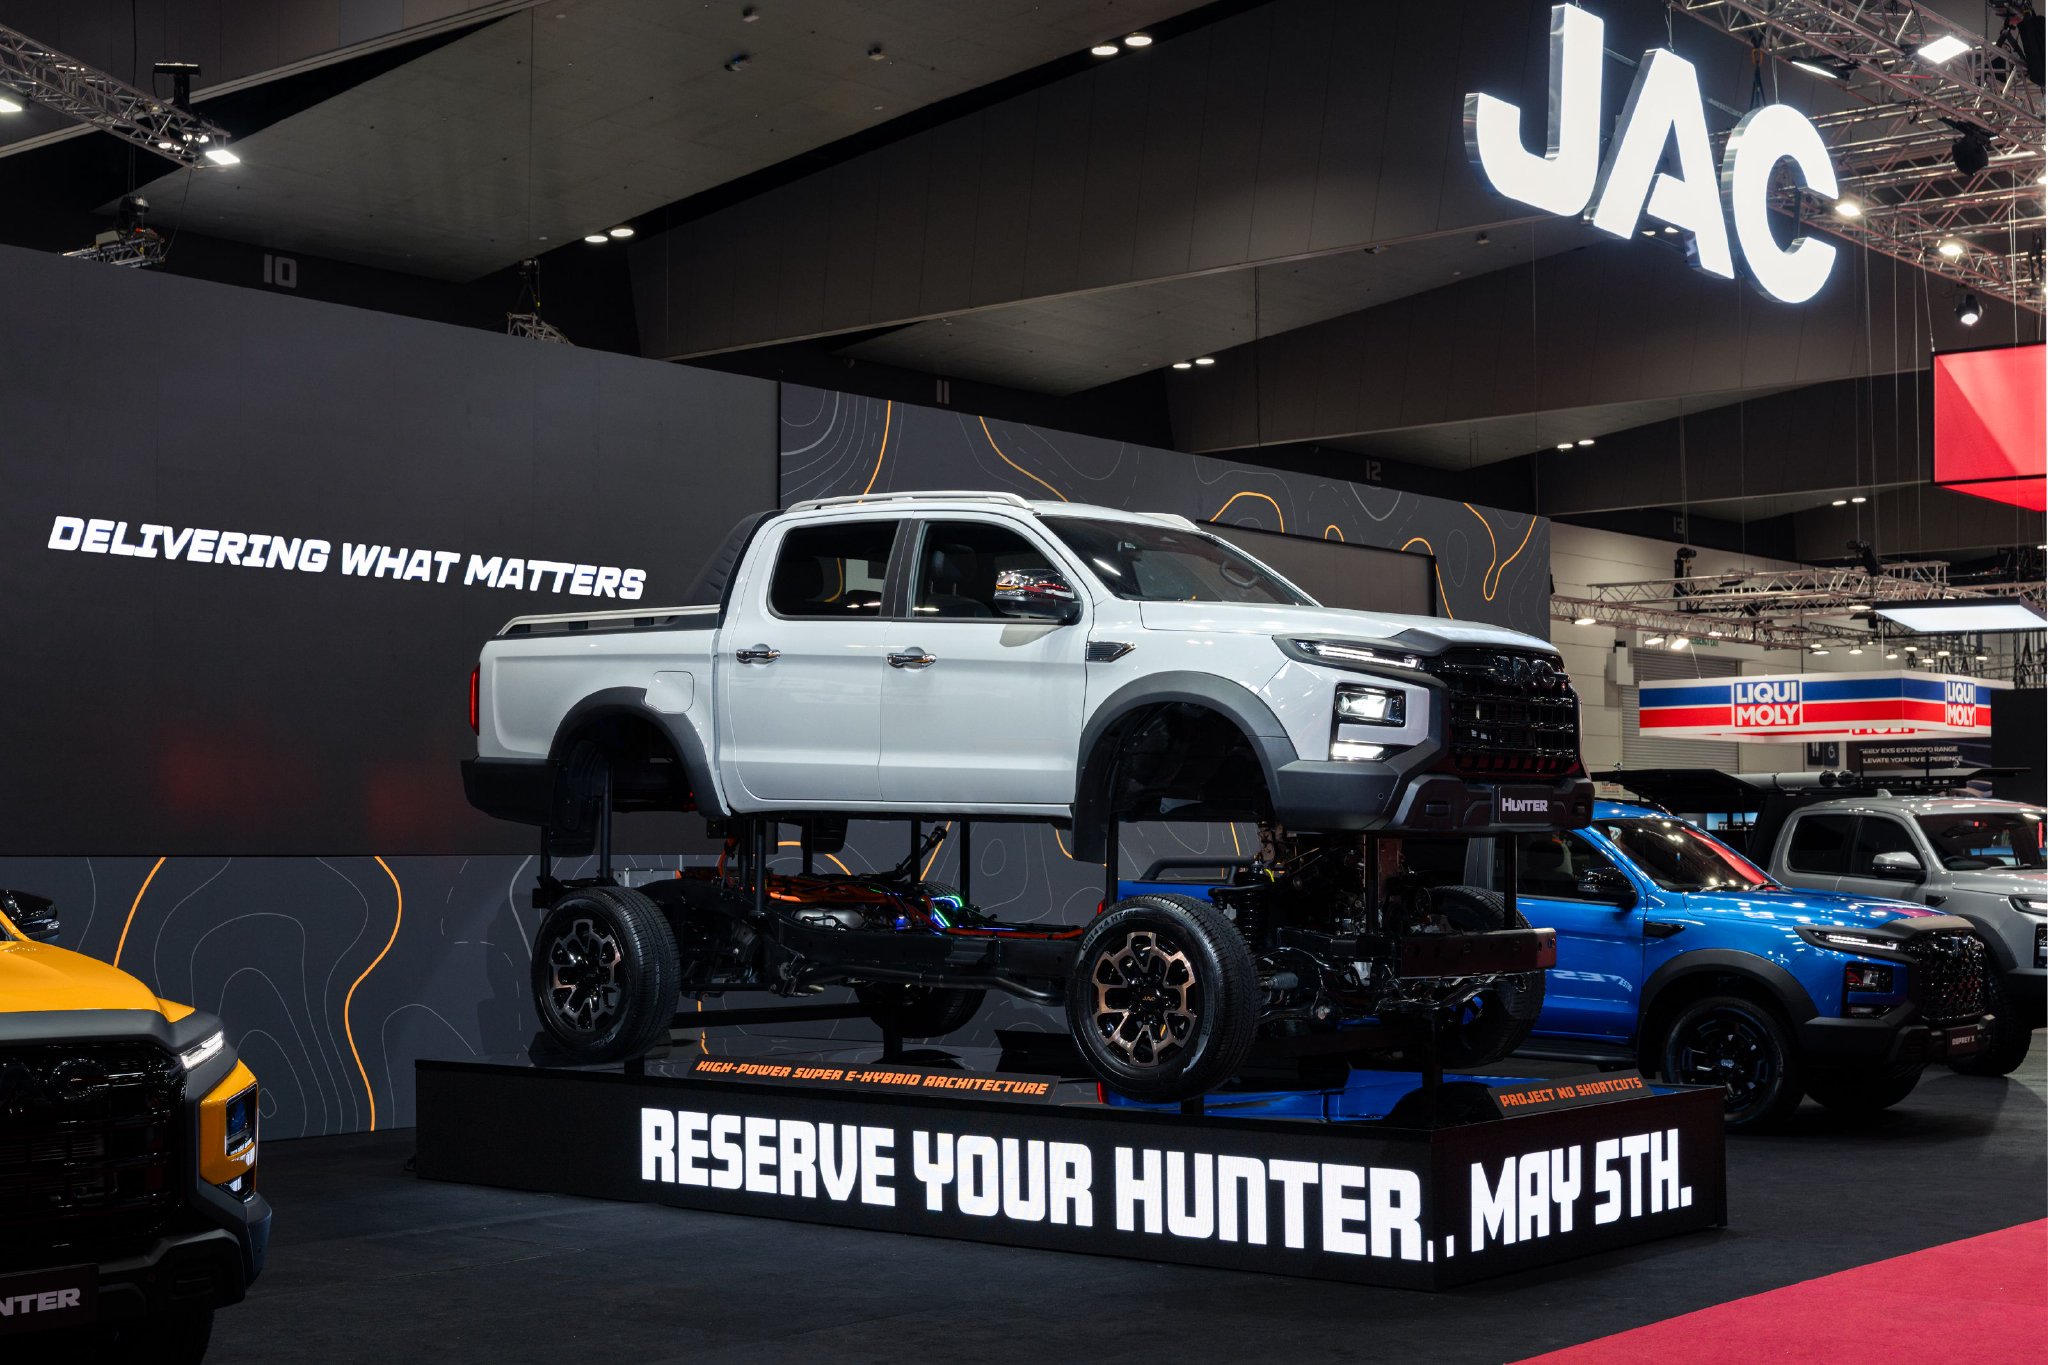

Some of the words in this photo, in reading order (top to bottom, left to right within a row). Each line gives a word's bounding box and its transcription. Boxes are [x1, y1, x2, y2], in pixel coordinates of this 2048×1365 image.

[1464, 3, 1840, 304] JAC
[264, 253, 297, 289] 10
[936, 379, 950, 405] 11
[1366, 459, 1382, 481] 12
[48, 515, 332, 573] DELIVERING
[342, 543, 461, 583] WHAT
[464, 554, 647, 600] MATTERS
[1736, 681, 1797, 704] LIQUI
[1947, 682, 1974, 704] LIQUI
[1736, 704, 1800, 726] MOLY
[1948, 704, 1975, 726] MOLY
[1921, 755, 1963, 763] EPERIENCE
[1501, 797, 1548, 812] HUNTER
[696, 1060, 792, 1077] HIGH-POWER
[792, 1067, 844, 1081] SUPER
[845, 1070, 922, 1086] E-HYBRID
[922, 1075, 1049, 1095] ARCHITECTURE
[1500, 1088, 1555, 1108] PROJECT
[1556, 1085, 1576, 1099] NO
[1576, 1077, 1643, 1096] SHORTCUTS
[642, 1108, 896, 1206] RESERVE
[913, 1131, 1093, 1226] YOUR
[1472, 1144, 1582, 1252] MAY
[1596, 1128, 1692, 1225] 5TH.
